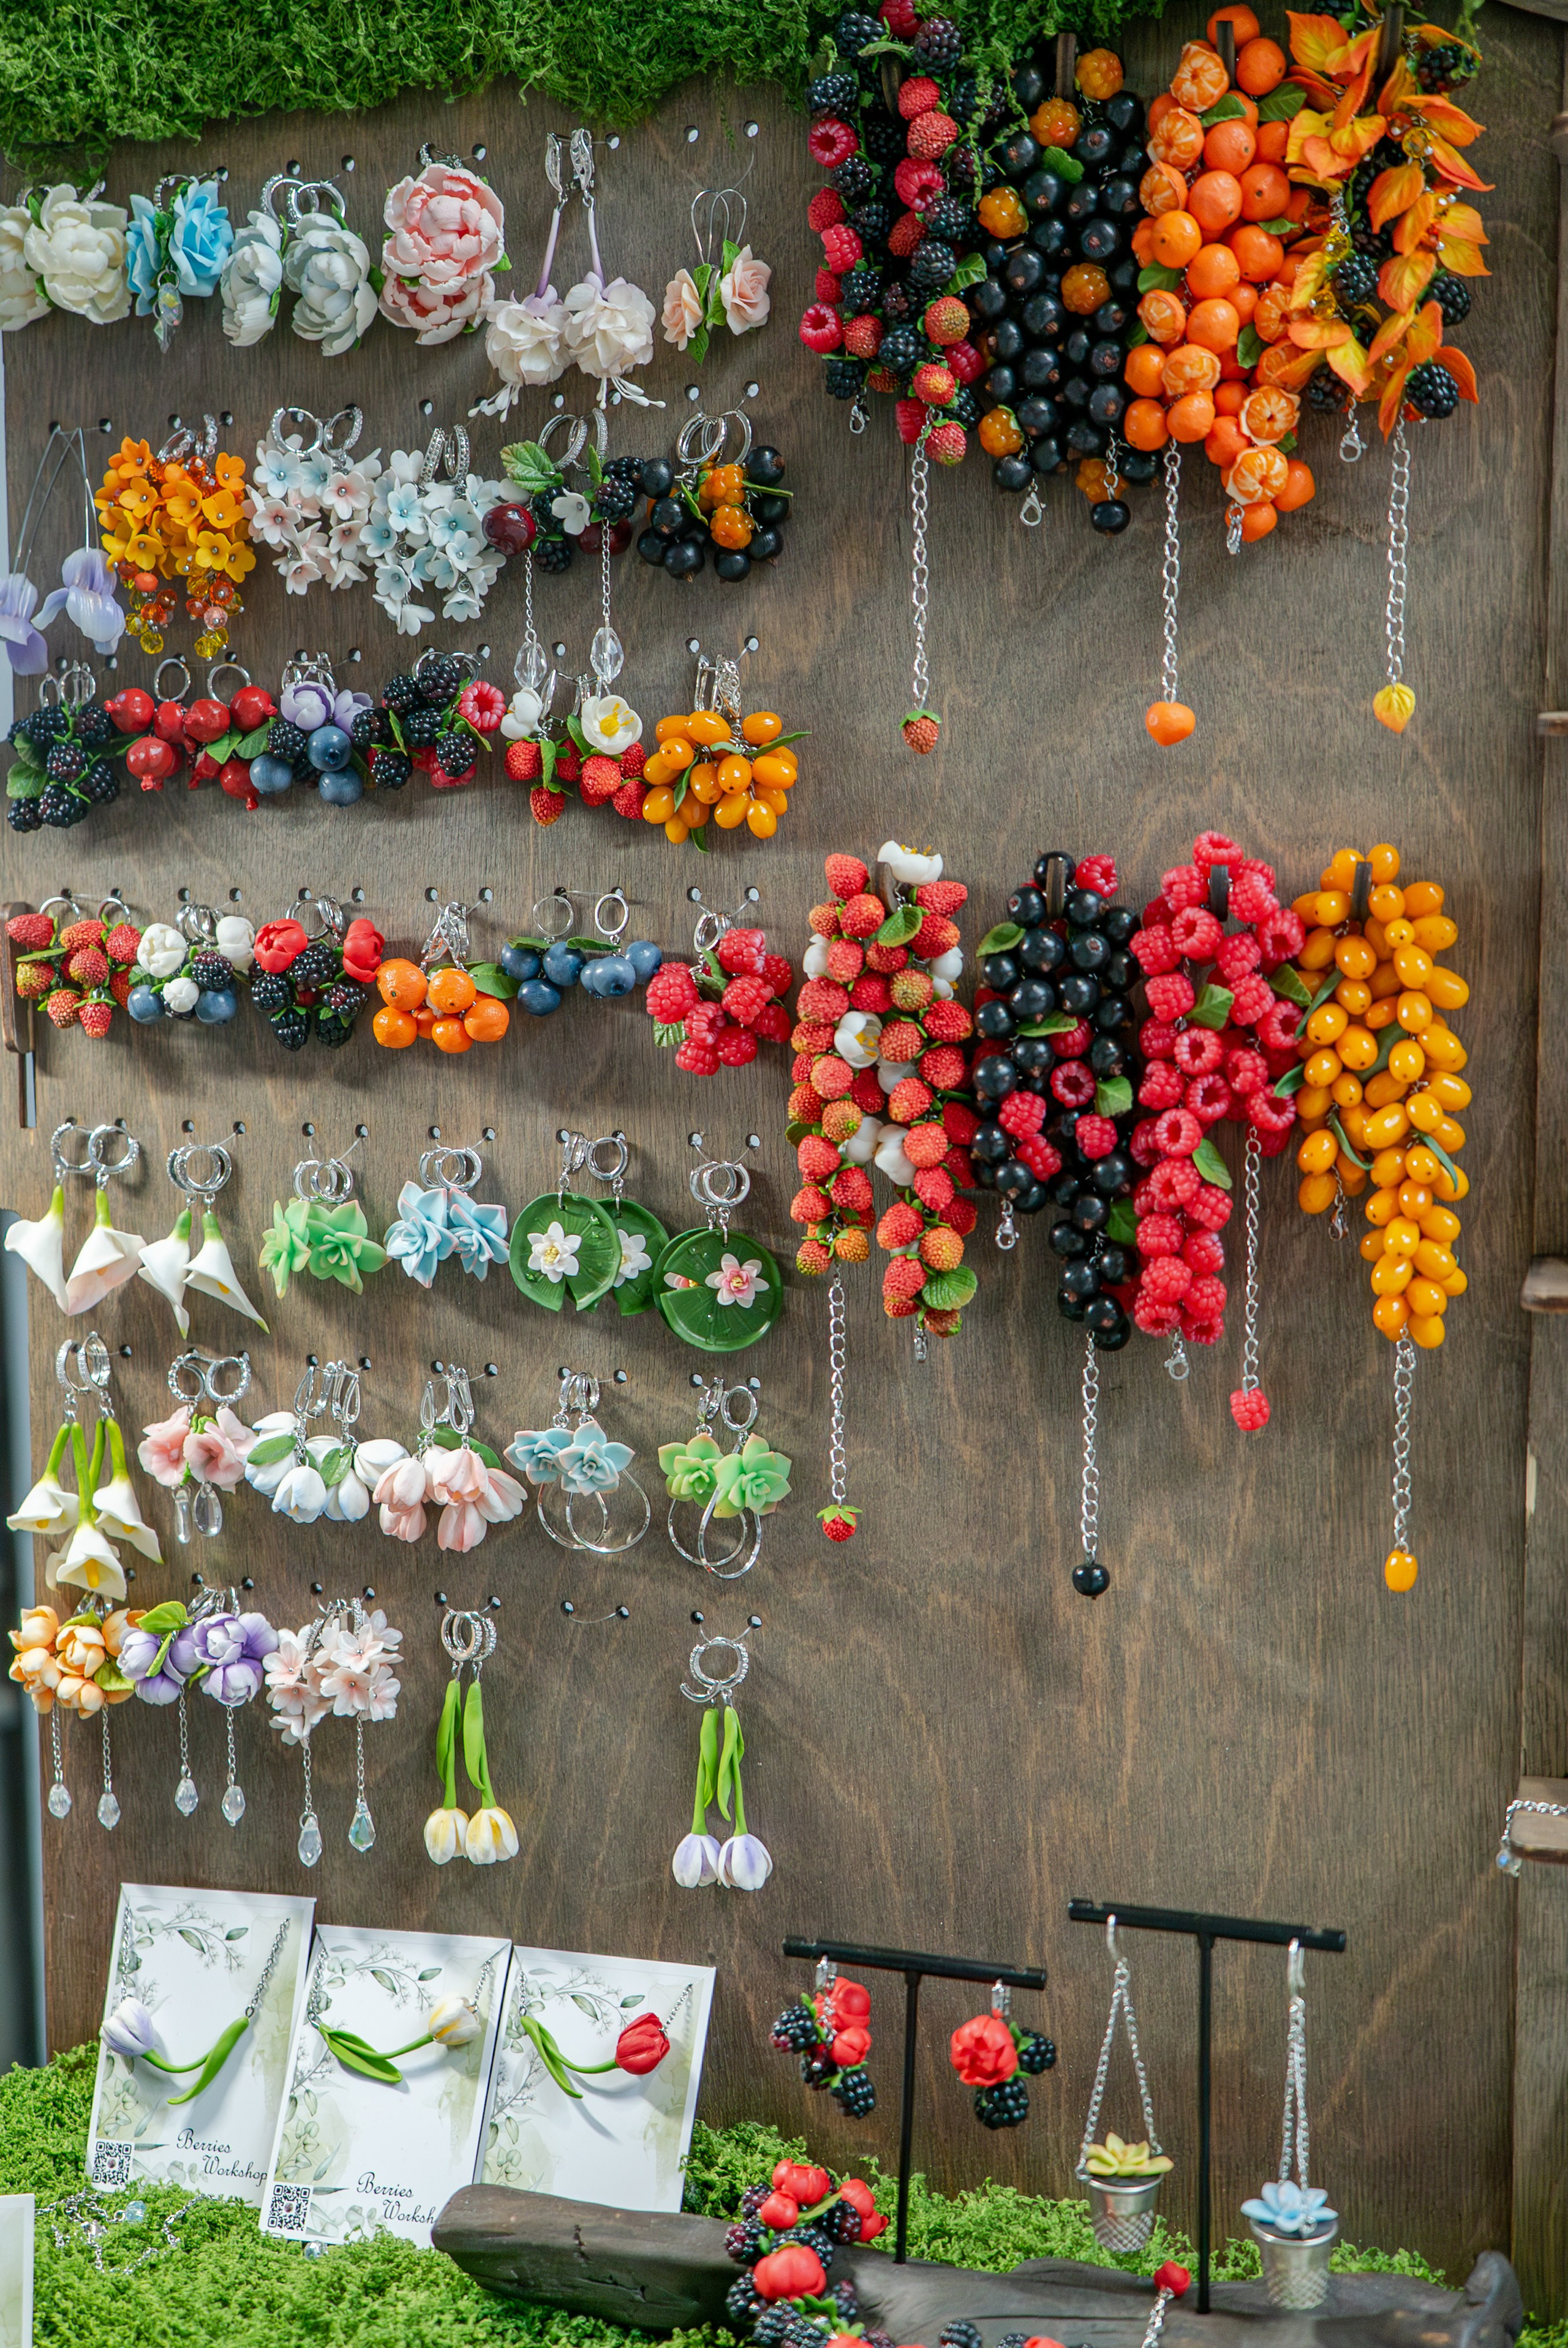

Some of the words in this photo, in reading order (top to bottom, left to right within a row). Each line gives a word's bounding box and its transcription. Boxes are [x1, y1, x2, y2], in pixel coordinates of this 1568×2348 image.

[176, 2127, 232, 2153] Berries
[202, 2154, 268, 2187] Workshop
[356, 2172, 414, 2198] Berries
[383, 2199, 437, 2224] Worksh
